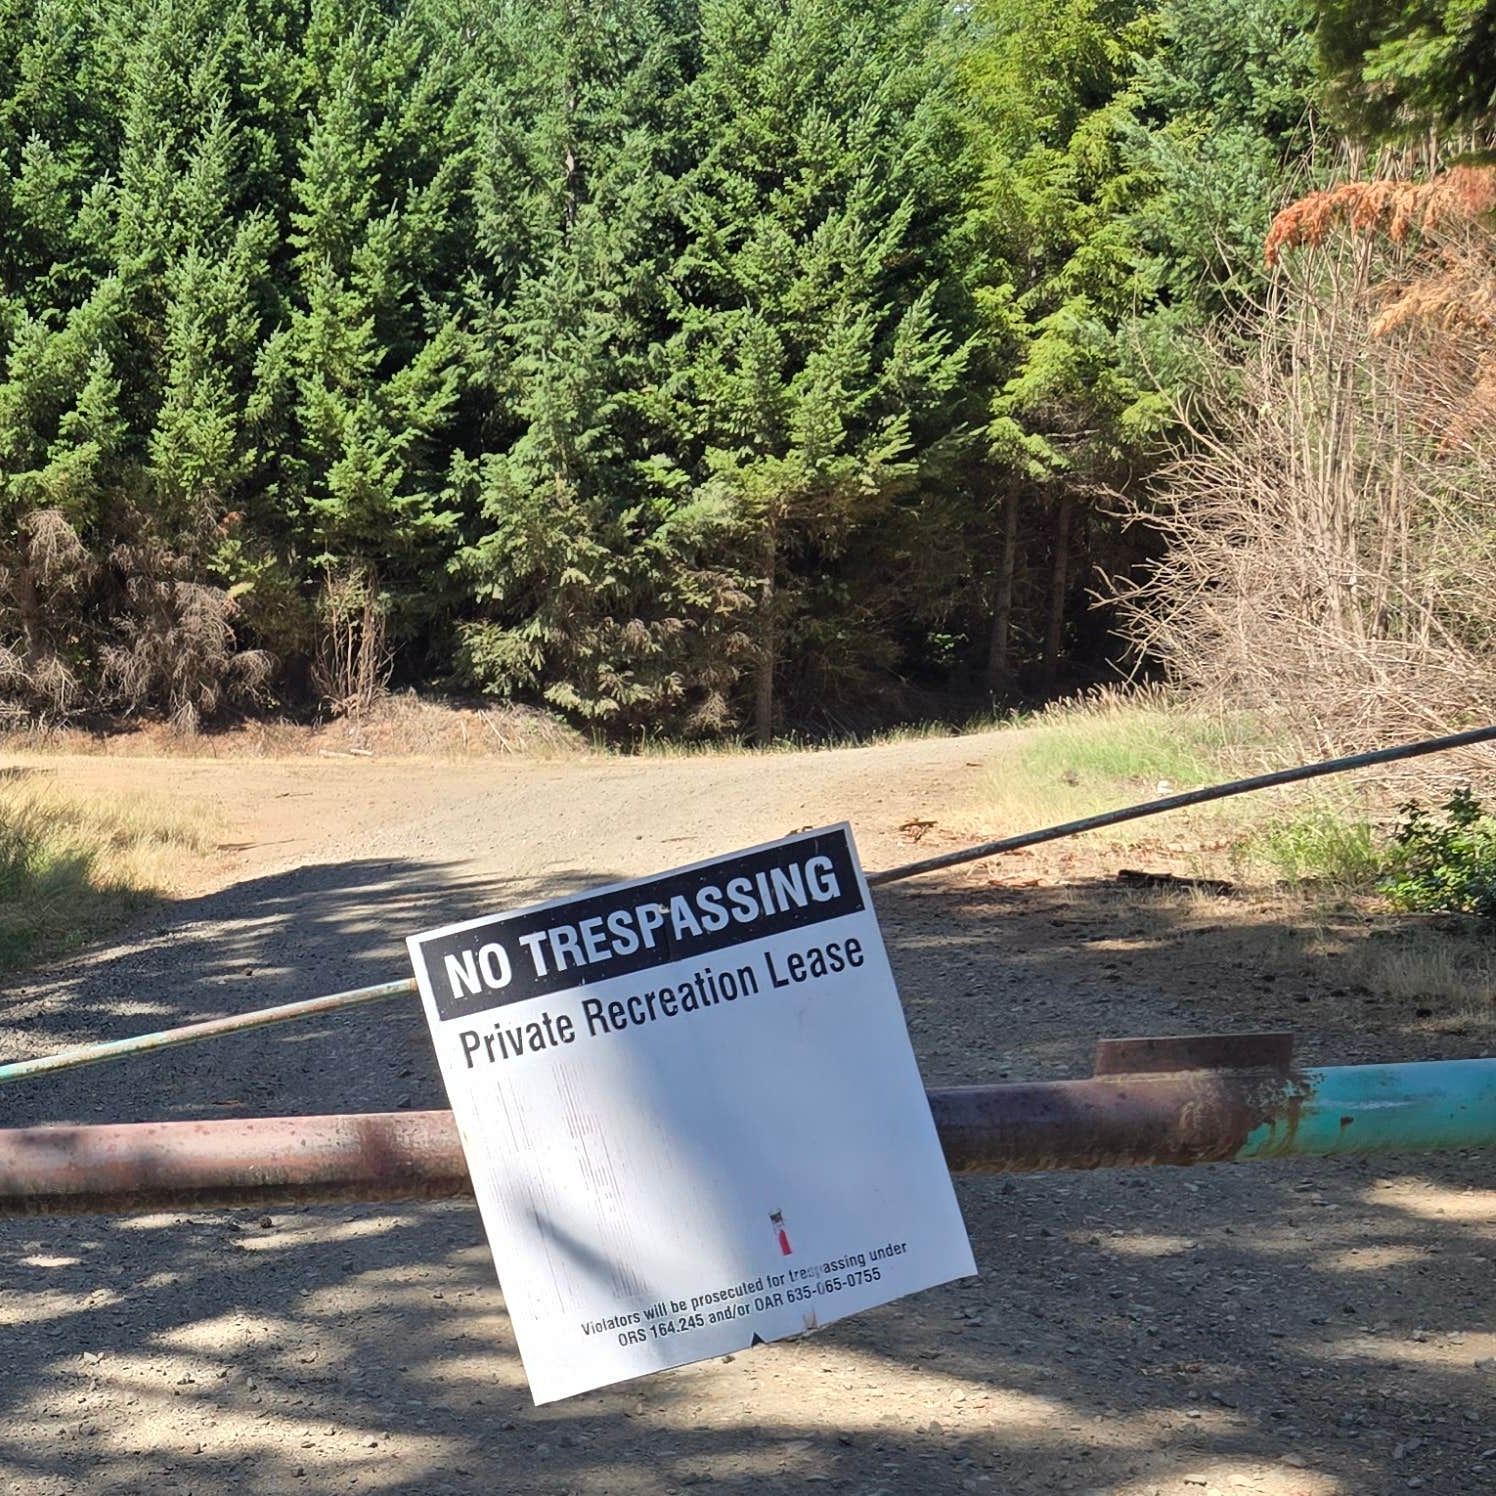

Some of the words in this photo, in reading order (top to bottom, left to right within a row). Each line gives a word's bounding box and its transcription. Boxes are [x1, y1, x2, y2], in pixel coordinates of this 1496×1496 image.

[444, 944, 512, 999] NO
[519, 855, 841, 978] TRESPASSING
[459, 1011, 576, 1069] Private
[581, 964, 759, 1037] Recreation
[763, 936, 865, 988] Lease
[581, 1311, 641, 1337] Violators
[644, 1303, 668, 1321] will
[670, 1299, 688, 1314] be
[691, 1278, 764, 1312] prosecuted
[767, 1272, 785, 1289] for
[869, 1241, 908, 1262] under
[618, 1330, 647, 1347] ORS
[650, 1317, 706, 1341] 164.245
[708, 1303, 751, 1325] and/or
[754, 1291, 784, 1312] OAR
[787, 1266, 882, 1304] 635-065-0755
